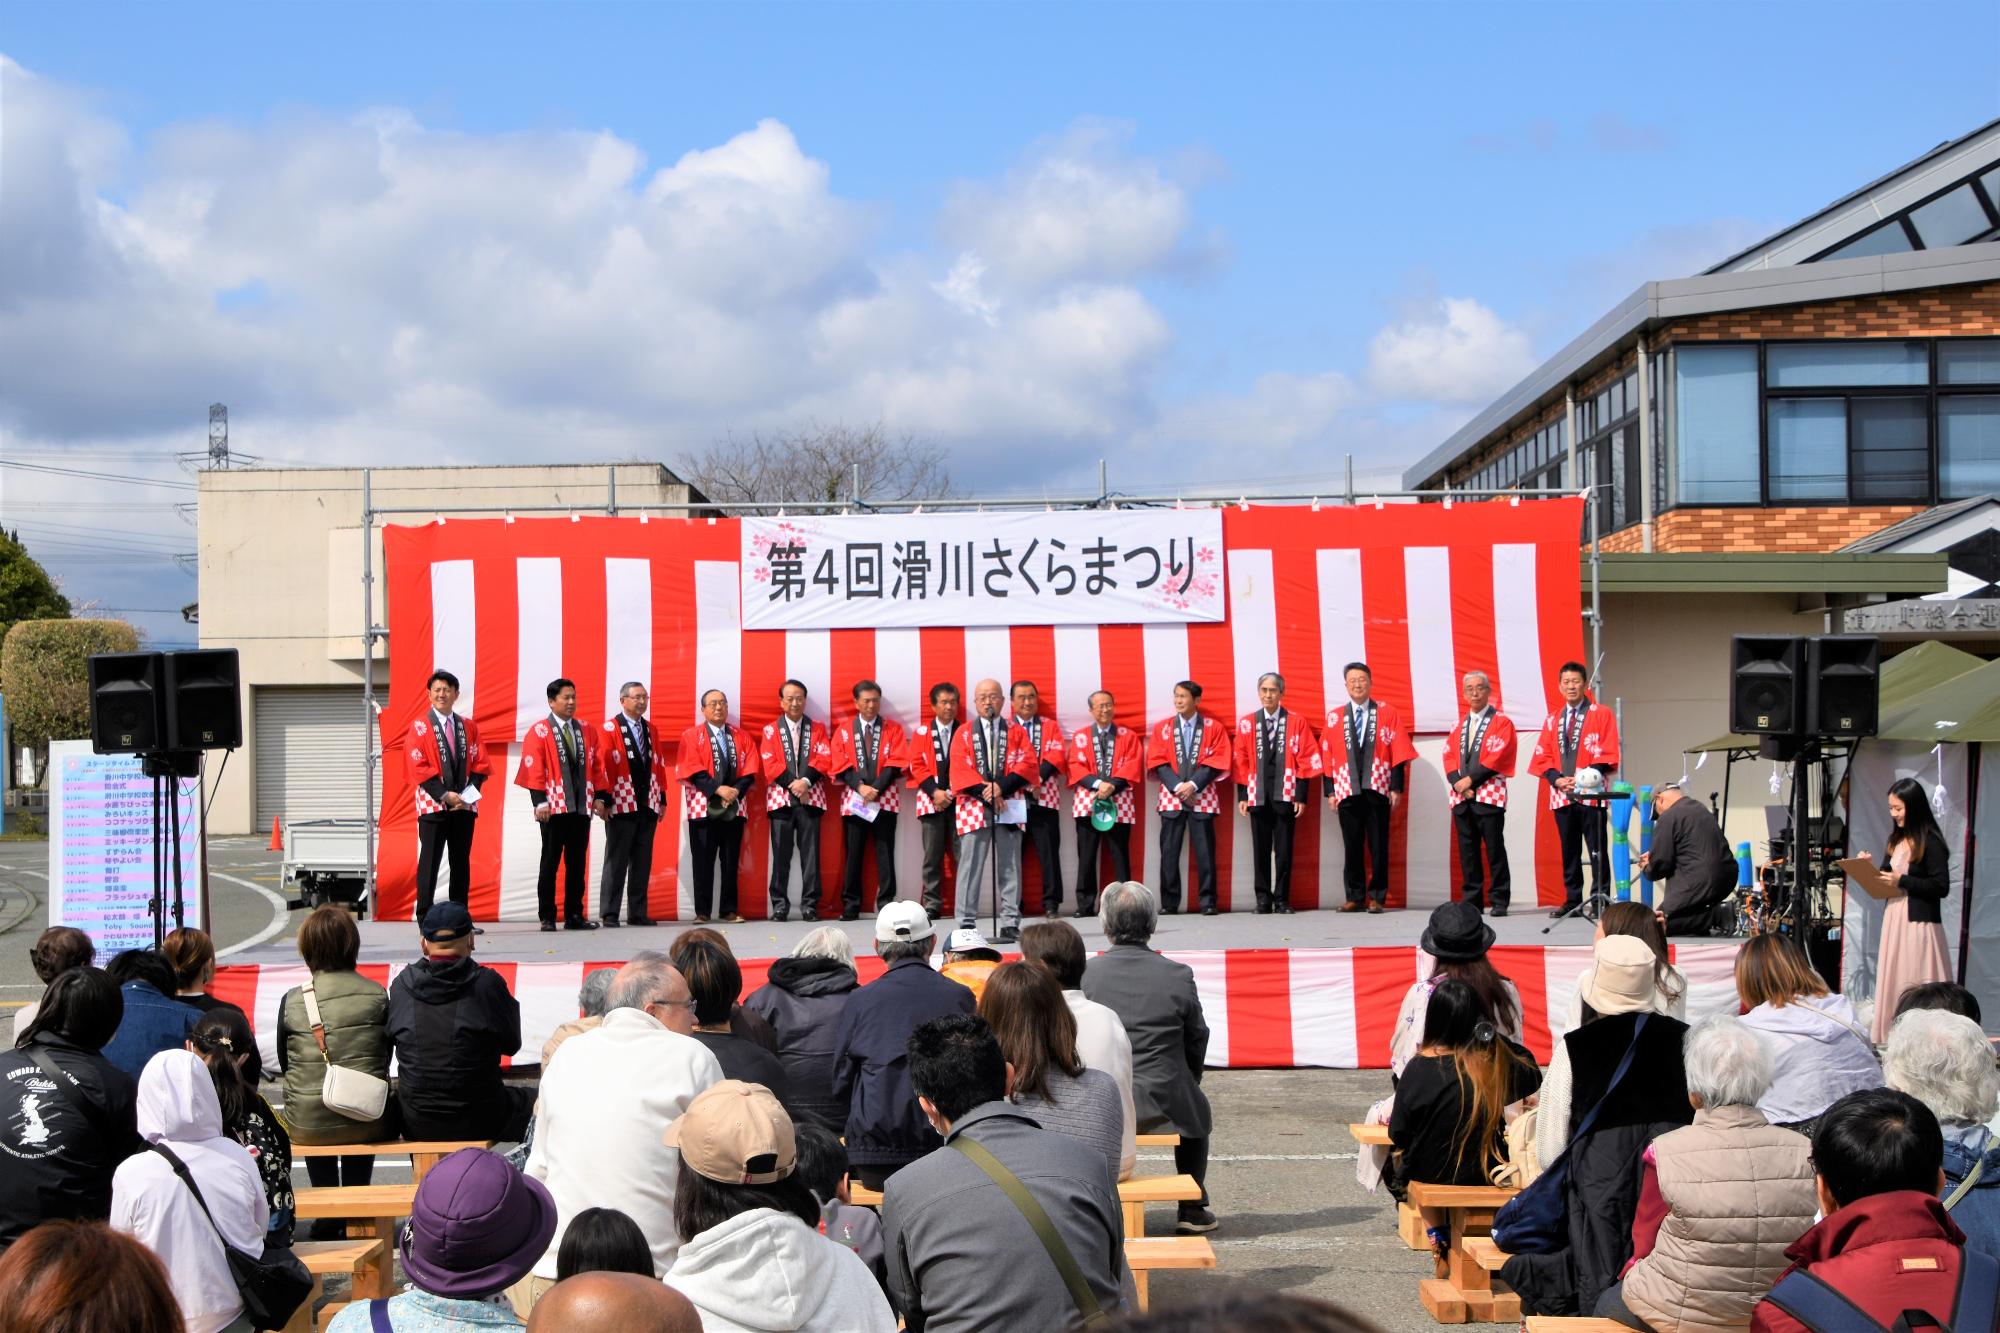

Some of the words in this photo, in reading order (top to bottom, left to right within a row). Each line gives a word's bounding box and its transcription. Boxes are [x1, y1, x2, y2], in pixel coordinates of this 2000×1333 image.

[766, 536, 1194, 602] 第4回滑川さくらまつり
[103, 923, 123, 931] Toby
